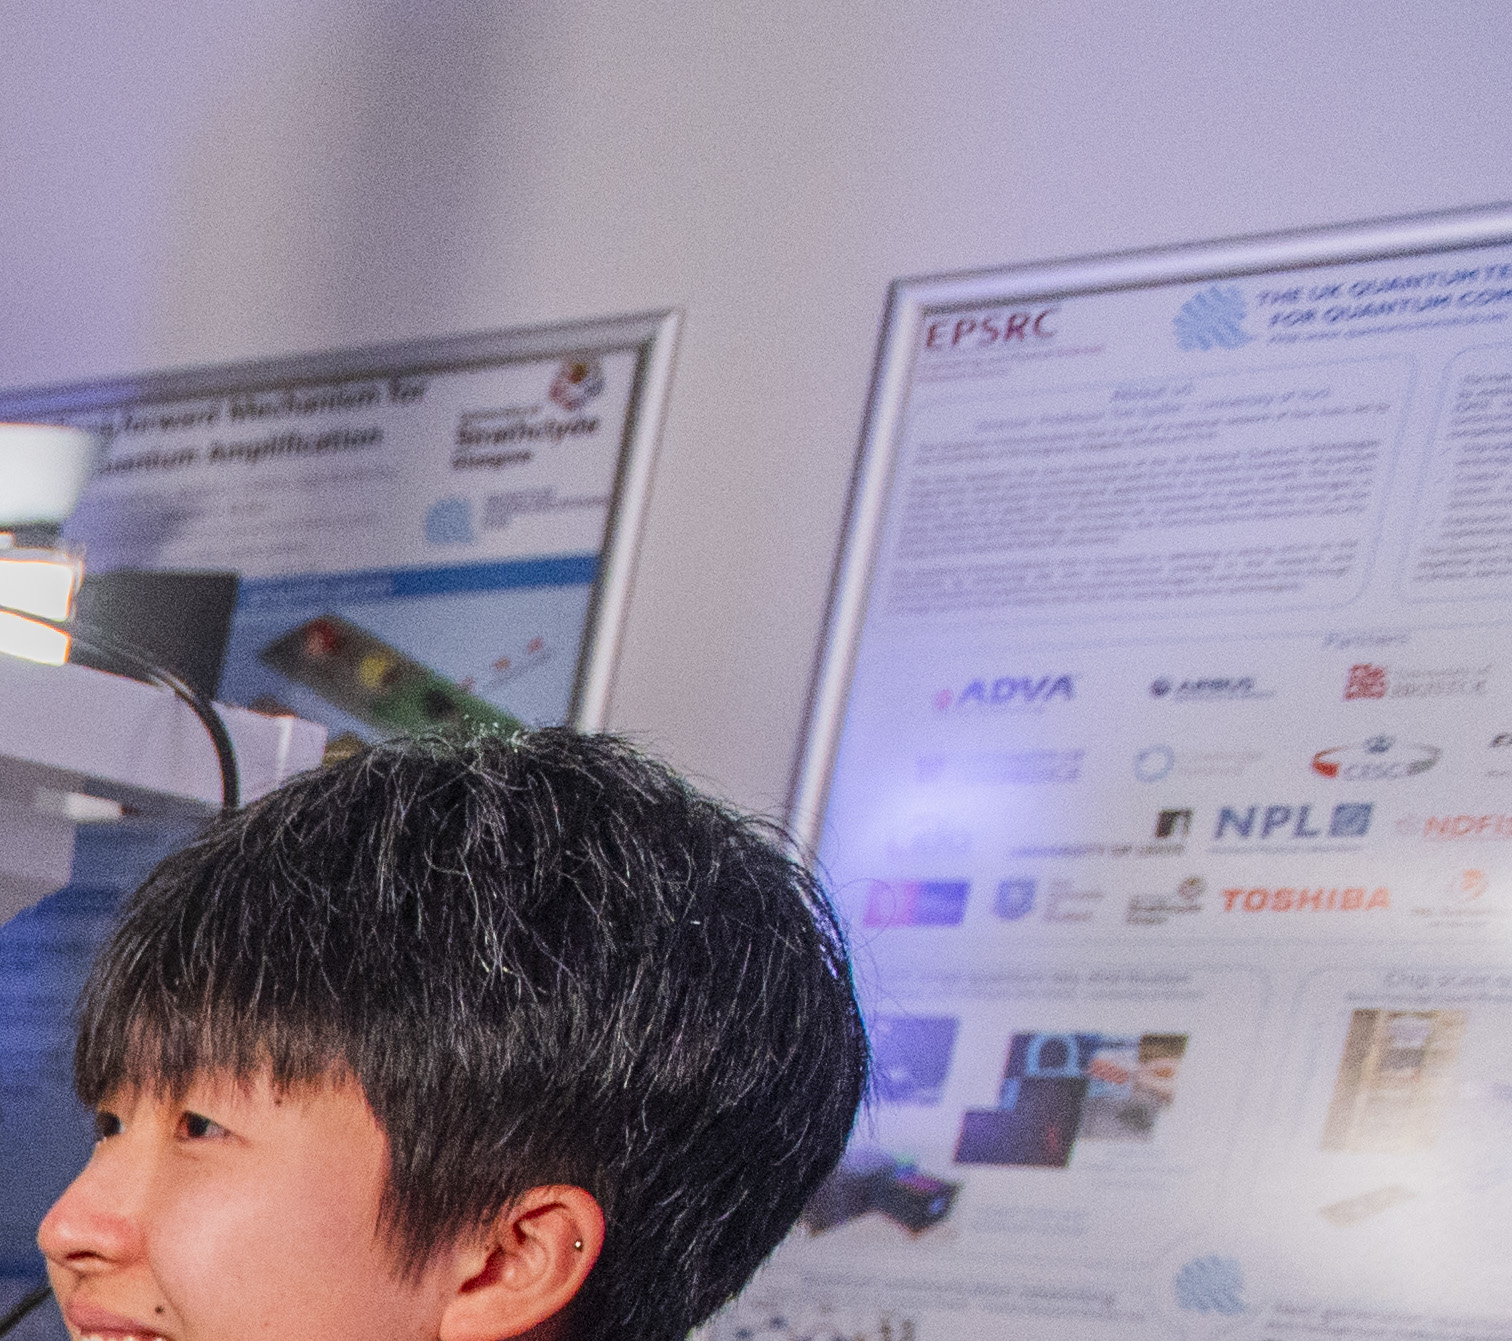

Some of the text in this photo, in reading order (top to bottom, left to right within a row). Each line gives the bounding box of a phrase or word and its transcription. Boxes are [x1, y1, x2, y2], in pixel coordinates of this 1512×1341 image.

[1348, 266, 1480, 297] QUANTUM
[1267, 308, 1316, 328] FOR
[1322, 294, 1453, 326] QUANTUM
[923, 307, 1058, 352] EPSRC
[957, 673, 1079, 703] ADVA
[1215, 805, 1319, 838] NPL
[1220, 888, 1392, 914] TOSHIBA
